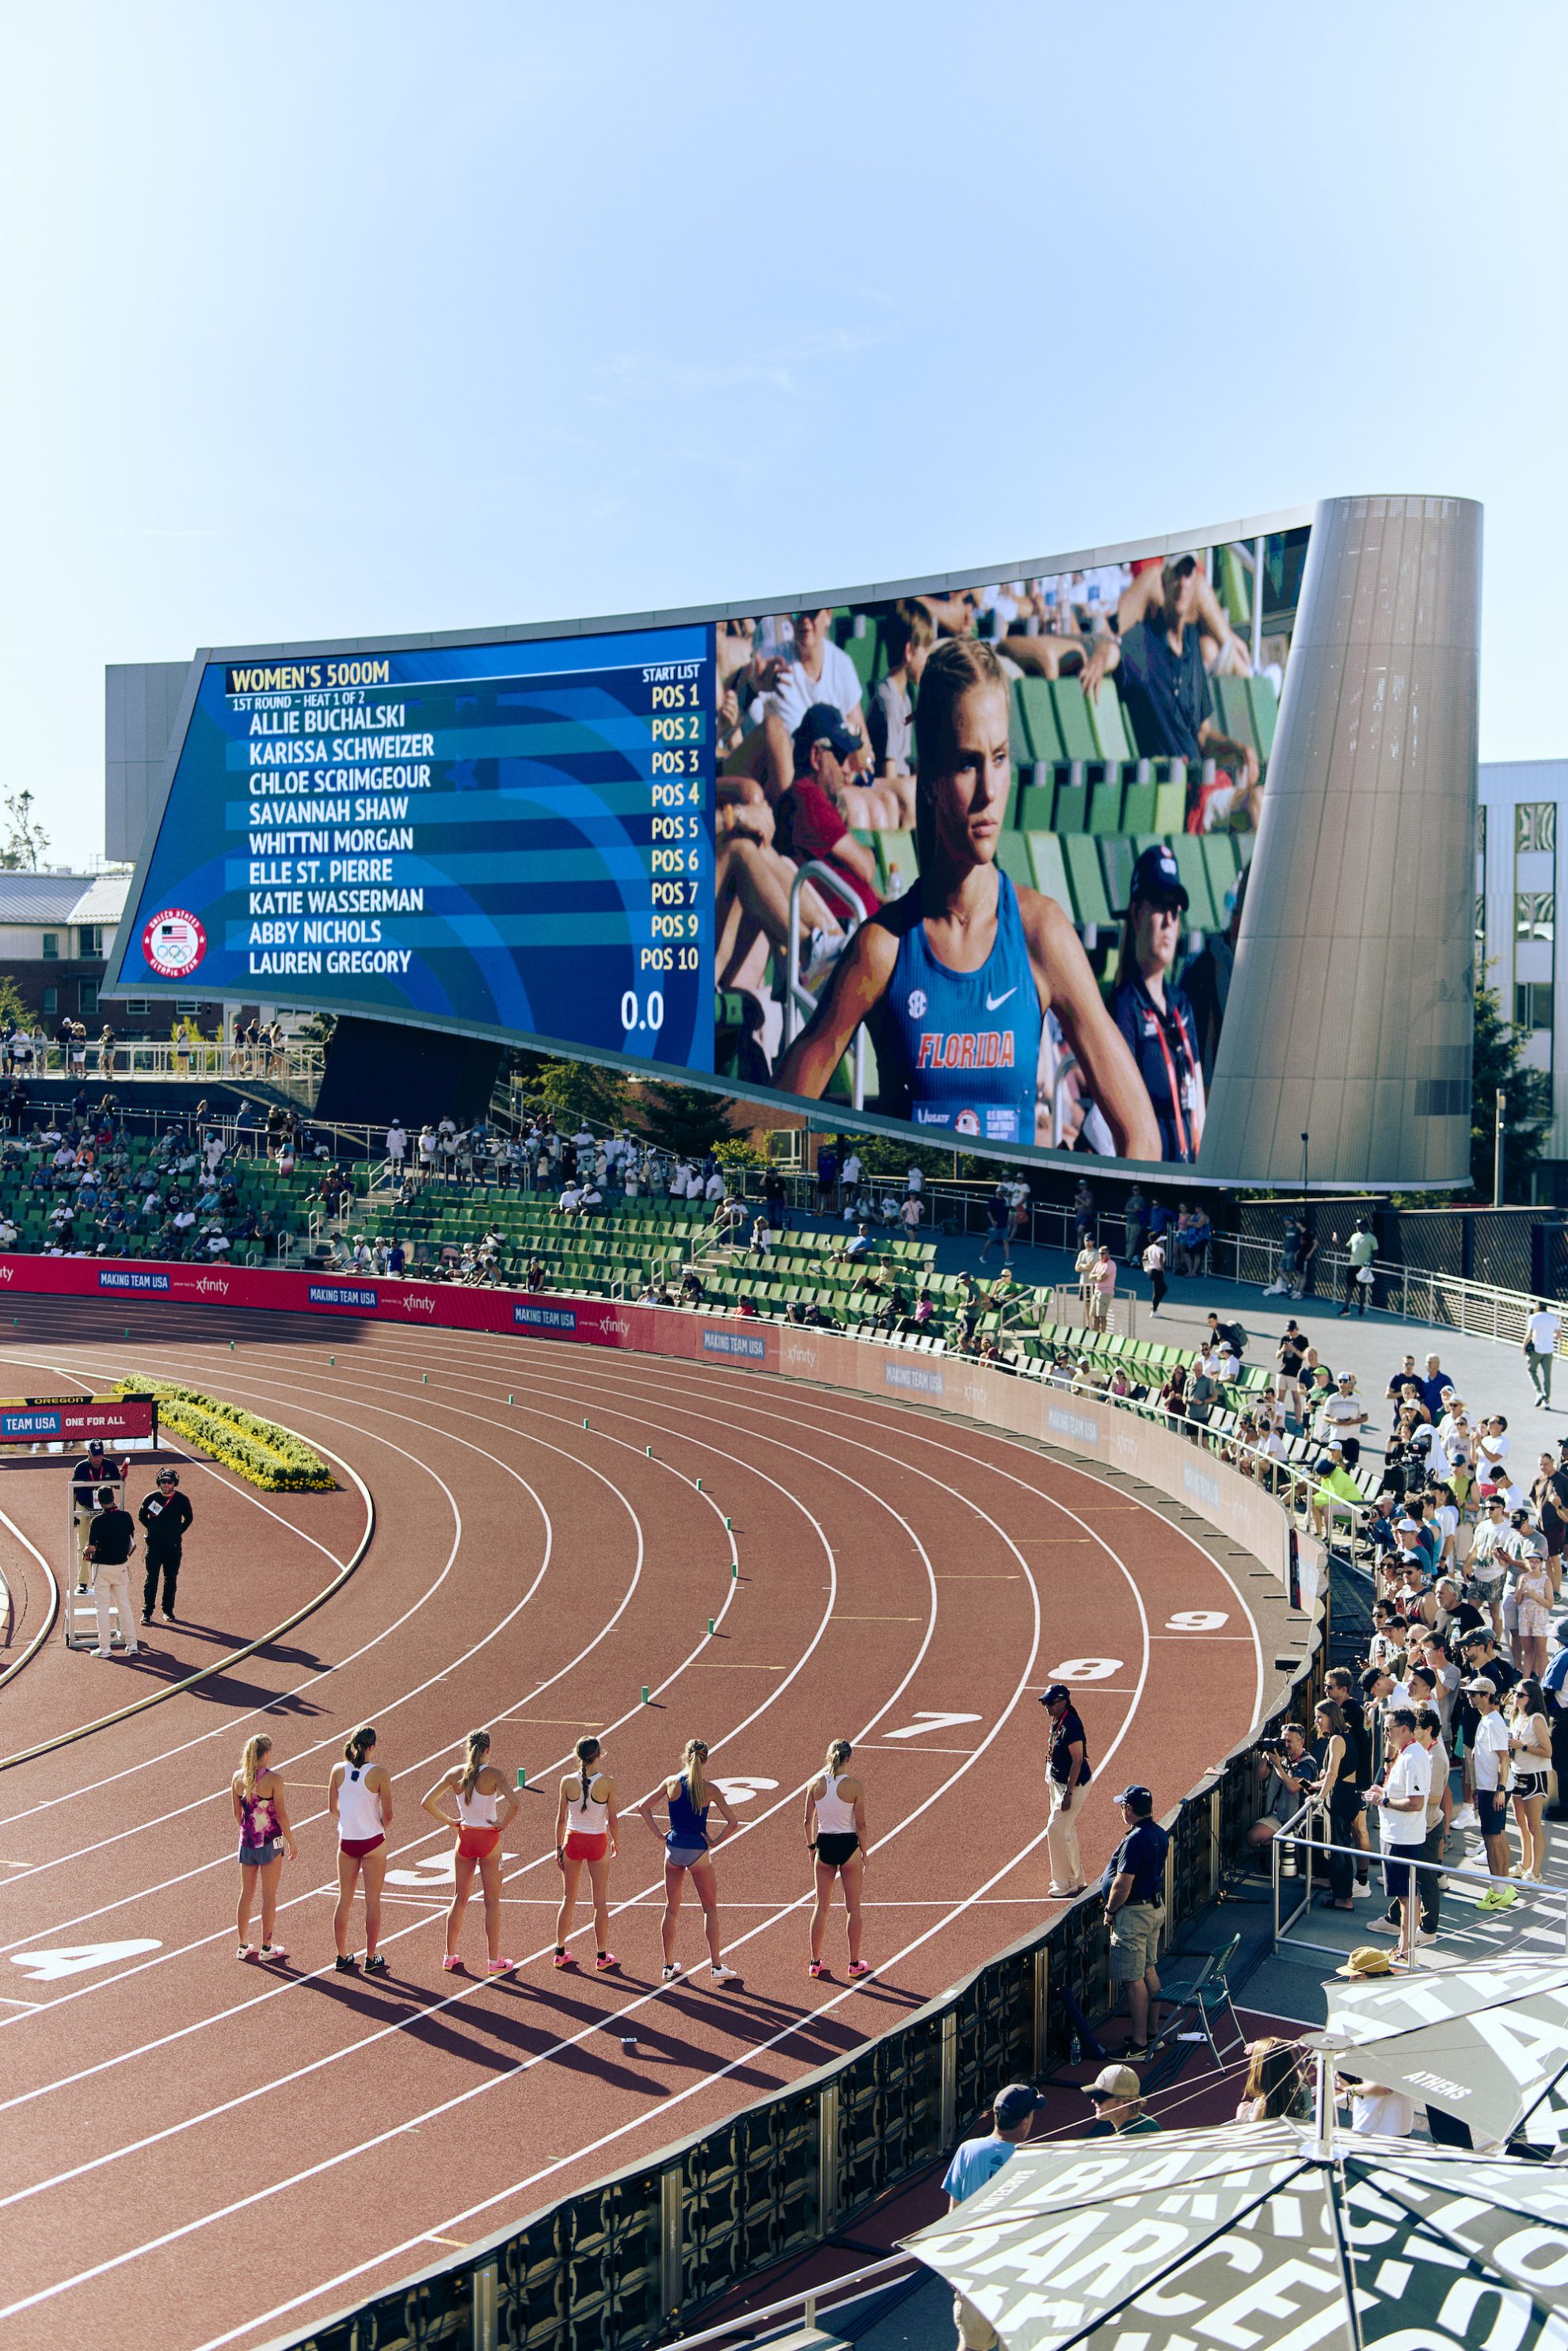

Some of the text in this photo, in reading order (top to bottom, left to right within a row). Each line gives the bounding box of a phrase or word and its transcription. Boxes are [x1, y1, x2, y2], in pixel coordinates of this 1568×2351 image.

[232, 660, 390, 692] WOMEN'S 5000M
[642, 664, 699, 683] START LIST
[233, 698, 253, 711] 1ST
[255, 696, 291, 709] ROUND
[304, 694, 331, 707] HEAT
[333, 693, 339, 706] 1
[342, 692, 356, 705] OF
[359, 691, 365, 704] 2
[652, 684, 699, 709] POS 1
[249, 704, 405, 736] ALLIE BUCHALSKI
[652, 717, 698, 741] POS 2
[249, 733, 435, 765] KARISSA SCHWEIZER
[652, 750, 698, 774] POS 3
[249, 765, 431, 795] CHLOE SCRIMGEOUR
[652, 782, 699, 807] POS 4
[249, 797, 409, 824] SAVANNAH SHAW
[652, 816, 698, 839] POS 5
[249, 827, 413, 854] WHITTNI MORGAN
[249, 858, 393, 884] ELLE ST. PIERRE
[652, 849, 698, 873] POS 6
[249, 888, 424, 915] KATIE WASSERMAN
[652, 882, 698, 904] POS 7
[249, 920, 382, 944] ABBY NICHOLS
[652, 915, 698, 937] POS 9
[249, 950, 412, 974] LAUREN GREGORY
[641, 948, 698, 970] POS 10
[621, 991, 664, 1030] 0.0
[915, 1030, 1014, 1068] FLORIDA
[927, 1113, 950, 1124] USATF
[101, 1273, 168, 1288] MAKING TEAM USA
[196, 1276, 229, 1295] xfinity
[310, 1288, 375, 1305] MAKING TEAM USA
[403, 1294, 436, 1314] xfinity
[516, 1307, 574, 1327] MAKING TEAM USA
[599, 1316, 630, 1337] xfinity
[705, 1333, 729, 1349] MAKING
[730, 1337, 748, 1352] TEAM
[749, 1340, 763, 1355] USA
[787, 1344, 816, 1368] xfinity
[886, 1366, 942, 1391] MAKING TEAM USA
[6, 1417, 55, 1430] TEAM USA
[65, 1416, 125, 1426] ONE FOR ALL
[1165, 1611, 1229, 1630] 9
[1048, 1658, 1125, 1680] 8
[882, 1711, 983, 1738] 7
[10, 1938, 163, 1980] 4
[1402, 2071, 1472, 2100] ATHENS
